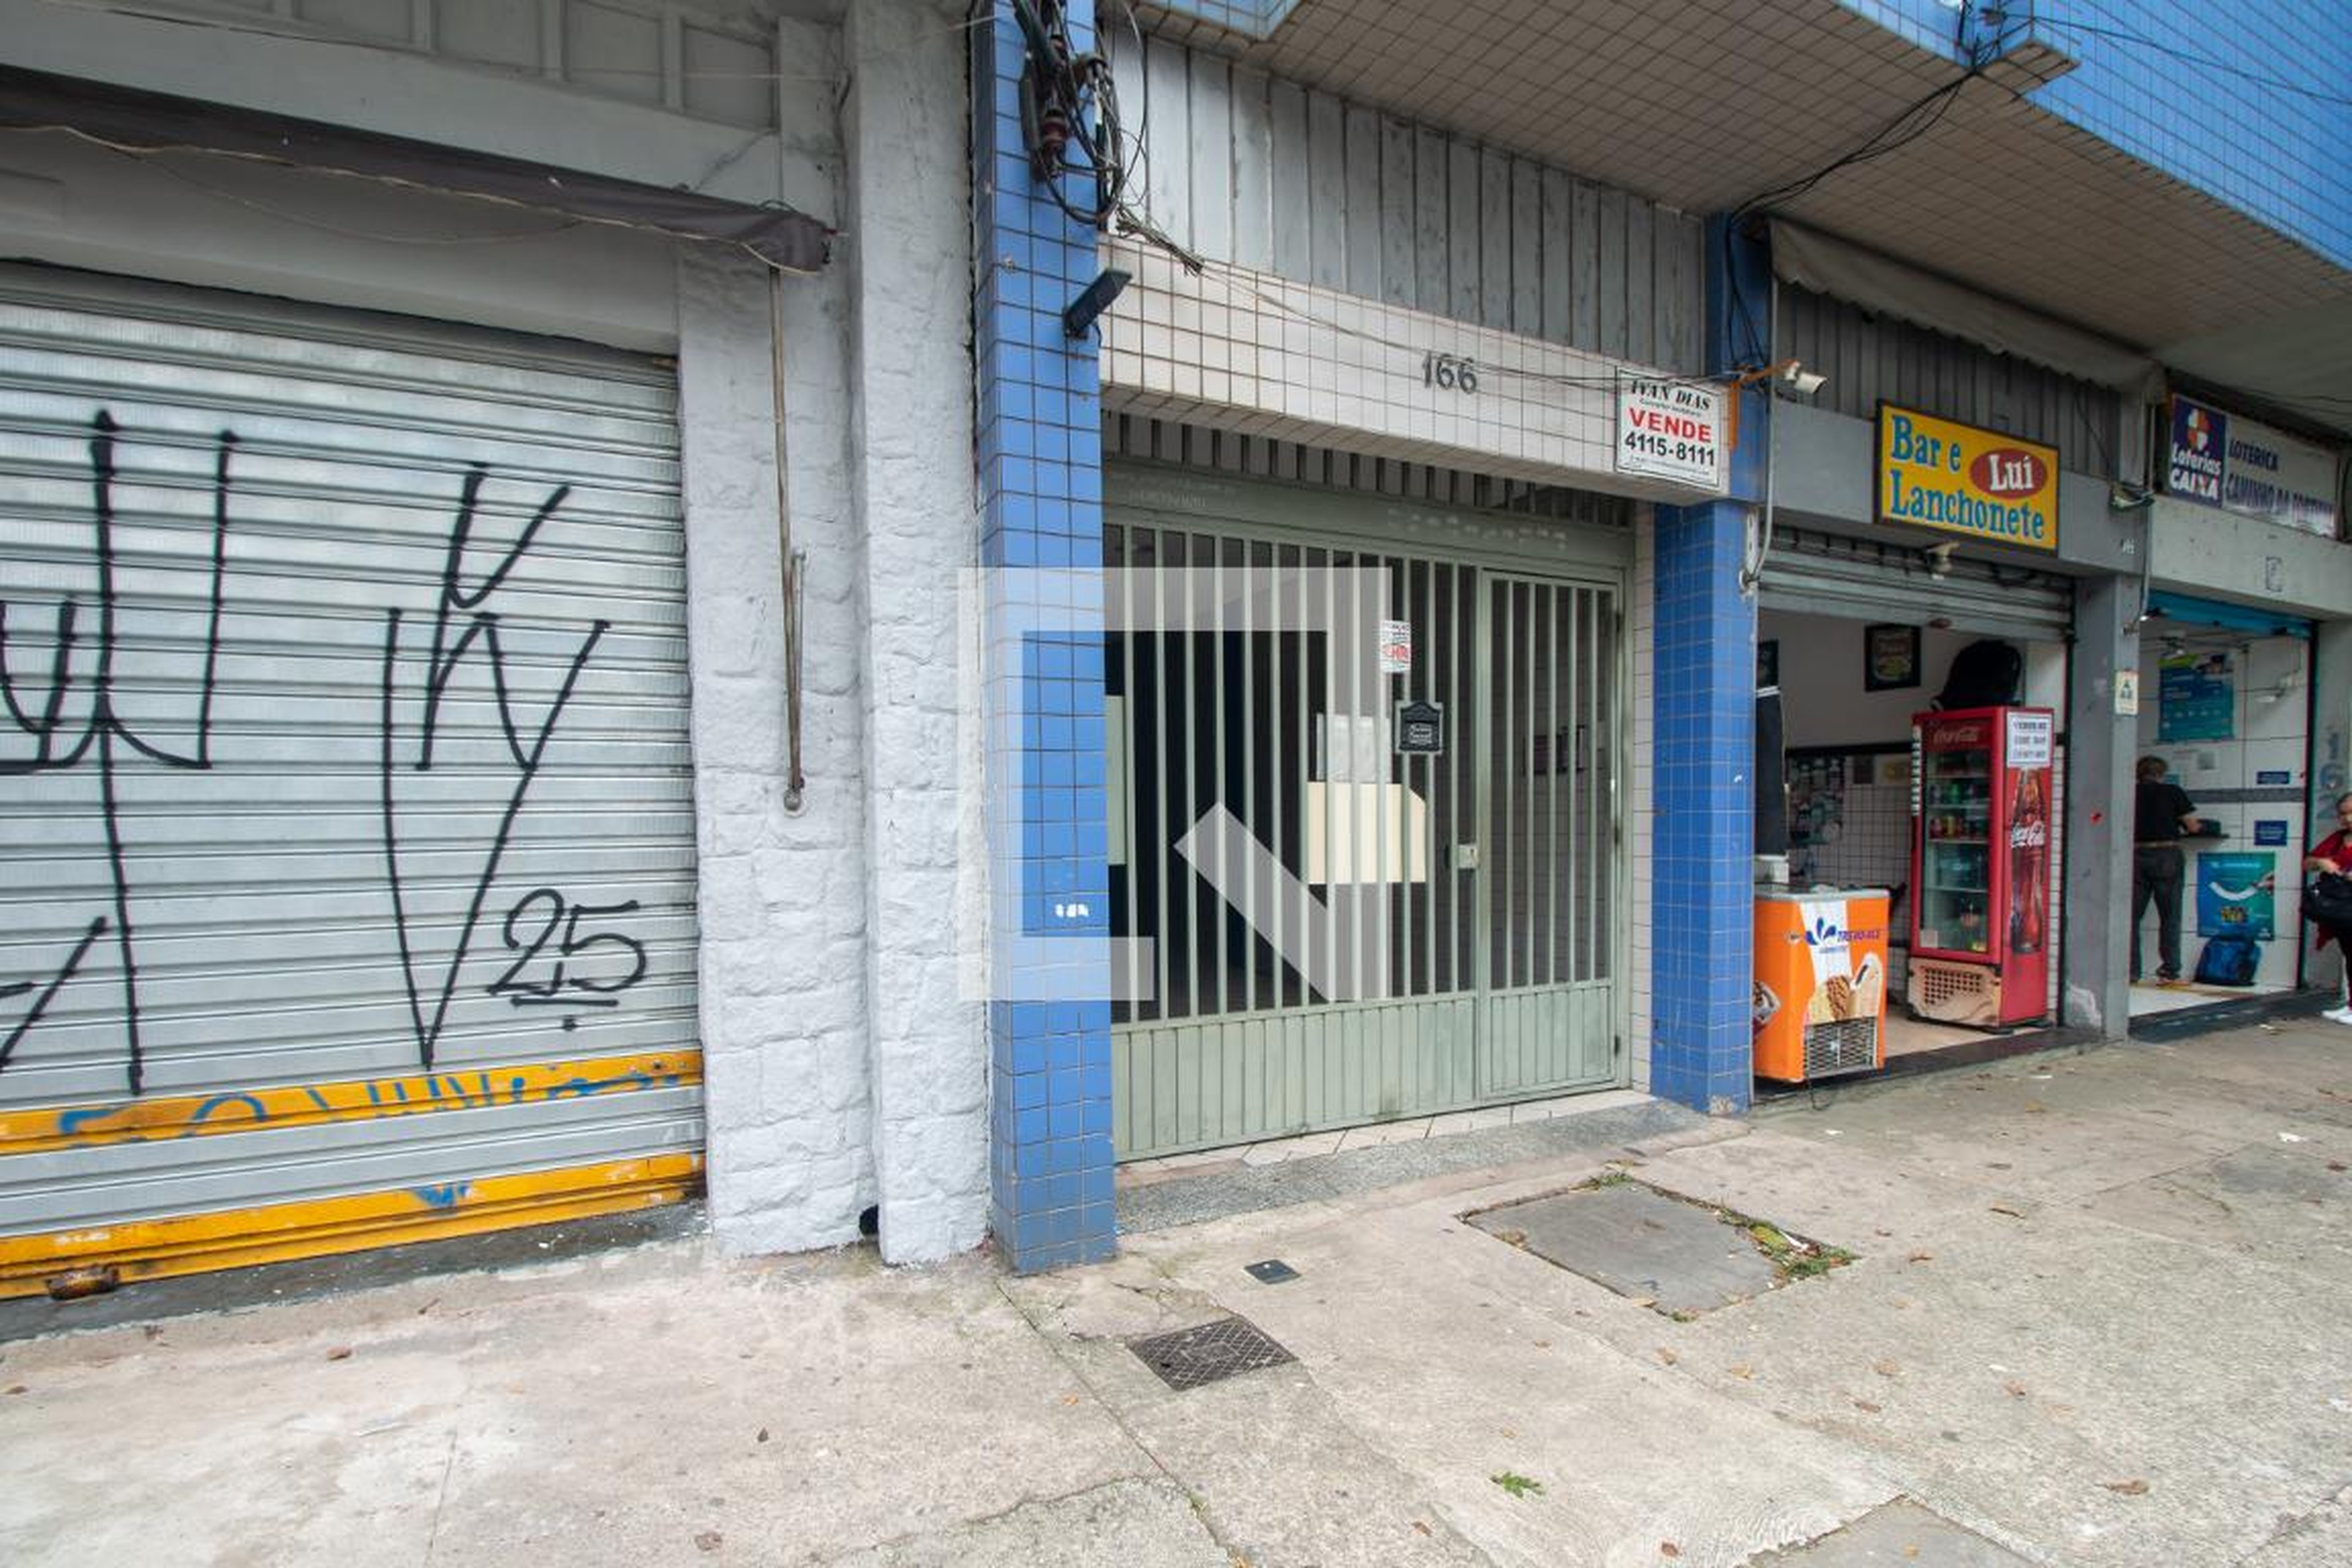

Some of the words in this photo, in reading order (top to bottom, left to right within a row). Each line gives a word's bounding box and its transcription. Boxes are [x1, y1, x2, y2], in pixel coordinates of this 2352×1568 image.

[1422, 351, 1477, 394] 166
[1676, 389, 1711, 411] DIAS
[1629, 407, 1712, 443] VENDE
[1624, 431, 1716, 467] 4115-8111
[1891, 415, 1941, 467] Bar
[1948, 442, 1961, 473] e
[2171, 442, 2222, 475] Loterias
[1988, 453, 2035, 491] Lui
[2169, 467, 2218, 501] CAIXA
[1890, 469, 2045, 541] Lanchonete
[487, 888, 647, 996] 25
